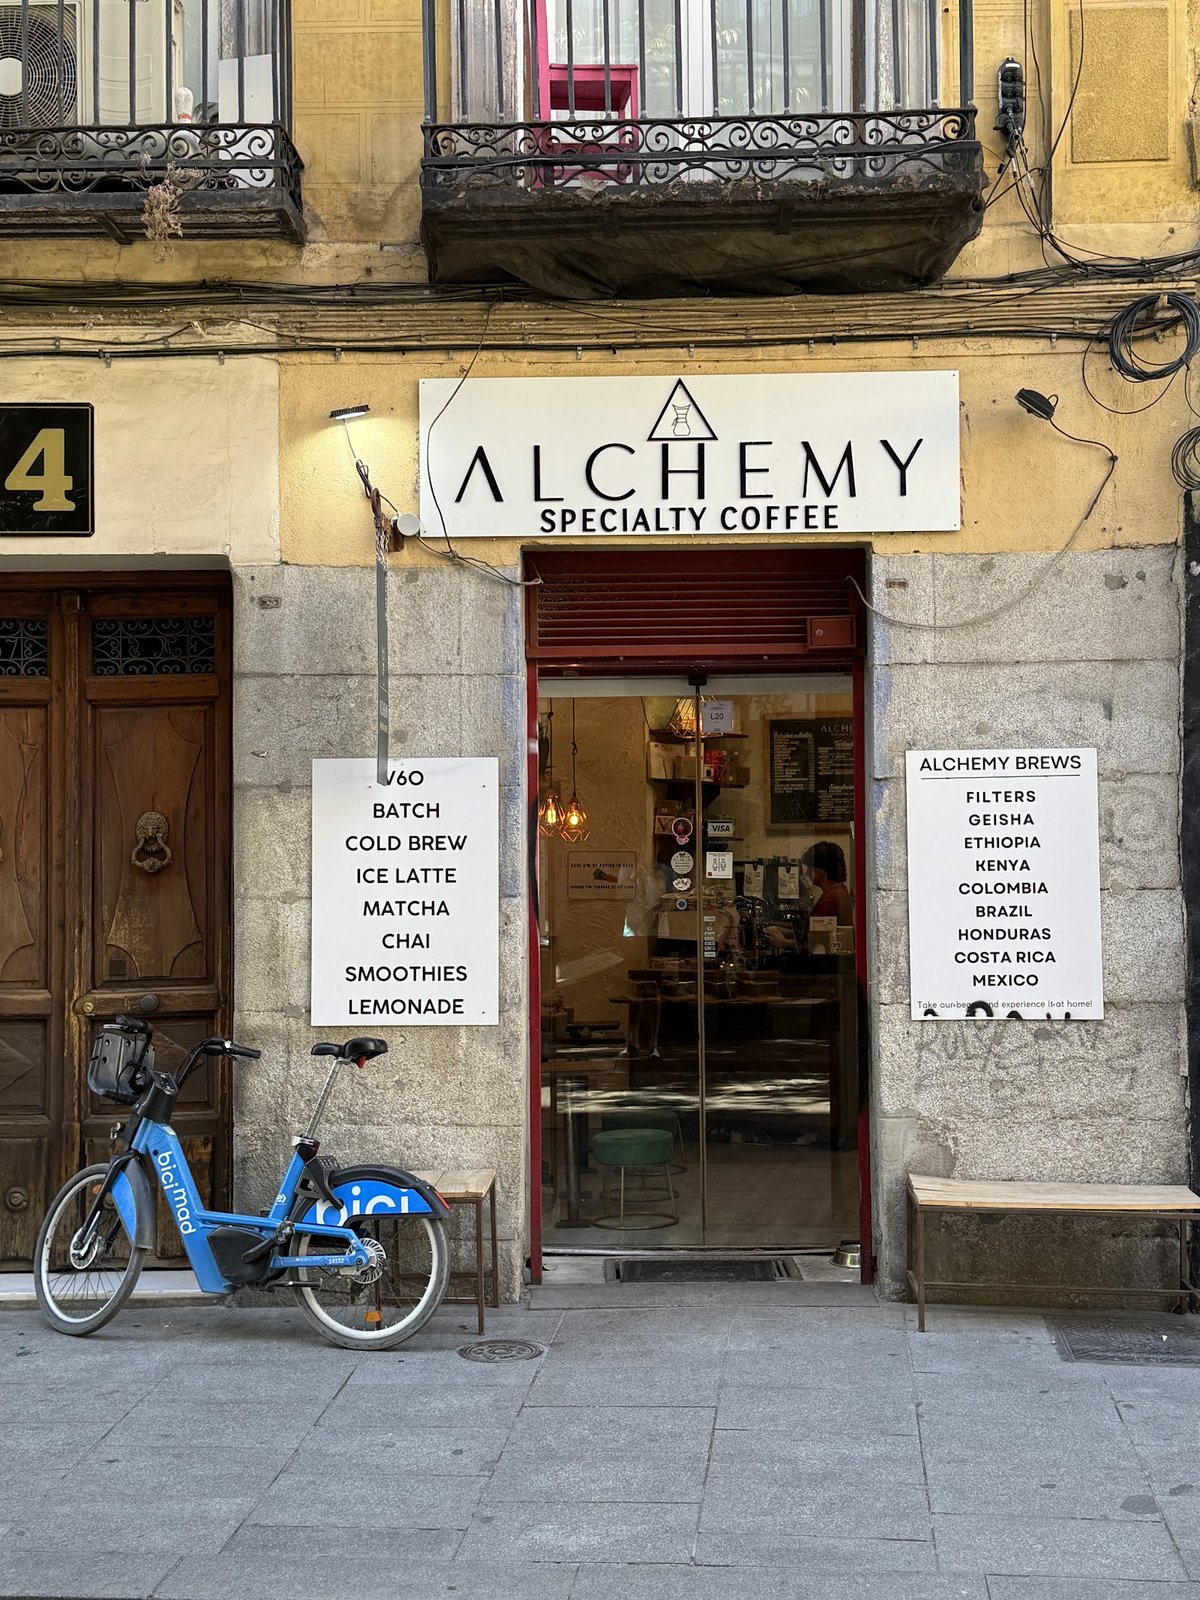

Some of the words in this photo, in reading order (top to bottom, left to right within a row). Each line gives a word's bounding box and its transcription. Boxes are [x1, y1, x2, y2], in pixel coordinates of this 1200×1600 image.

[5, 428, 76, 511] 4
[455, 438, 924, 503] ALCHEMY
[540, 506, 707, 533] SPECIALTY
[721, 505, 839, 530] COFFEE
[710, 712, 724, 720] L20
[919, 756, 1010, 772] ALCHEMY
[1015, 755, 1082, 770] BREWS
[967, 791, 1036, 804] FILTERS
[373, 803, 440, 819] BATCH
[969, 813, 1035, 826] GEISHA
[711, 824, 731, 832] VISA
[345, 835, 402, 852] COLD
[408, 835, 468, 851] BREW
[964, 836, 1041, 849] ETHIOPIA
[975, 859, 1031, 872] KENYA
[356, 868, 389, 884] ICE
[395, 868, 457, 884] LATTE
[958, 882, 1049, 895] COLOMBIA
[362, 900, 450, 917] MATCHA
[975, 905, 1033, 918] BRAZIL
[958, 927, 1051, 941] HONDURAS
[381, 933, 430, 950] CHAI
[954, 951, 1012, 964] COSTA
[1016, 950, 1057, 963] RICA
[345, 966, 468, 982] SMOOTHIES
[972, 974, 1039, 987] MEXICO
[348, 998, 465, 1015] LEMONADE
[917, 1001, 938, 1009] Take
[1001, 1001, 1046, 1010] experience
[1066, 1000, 1093, 1008] home!
